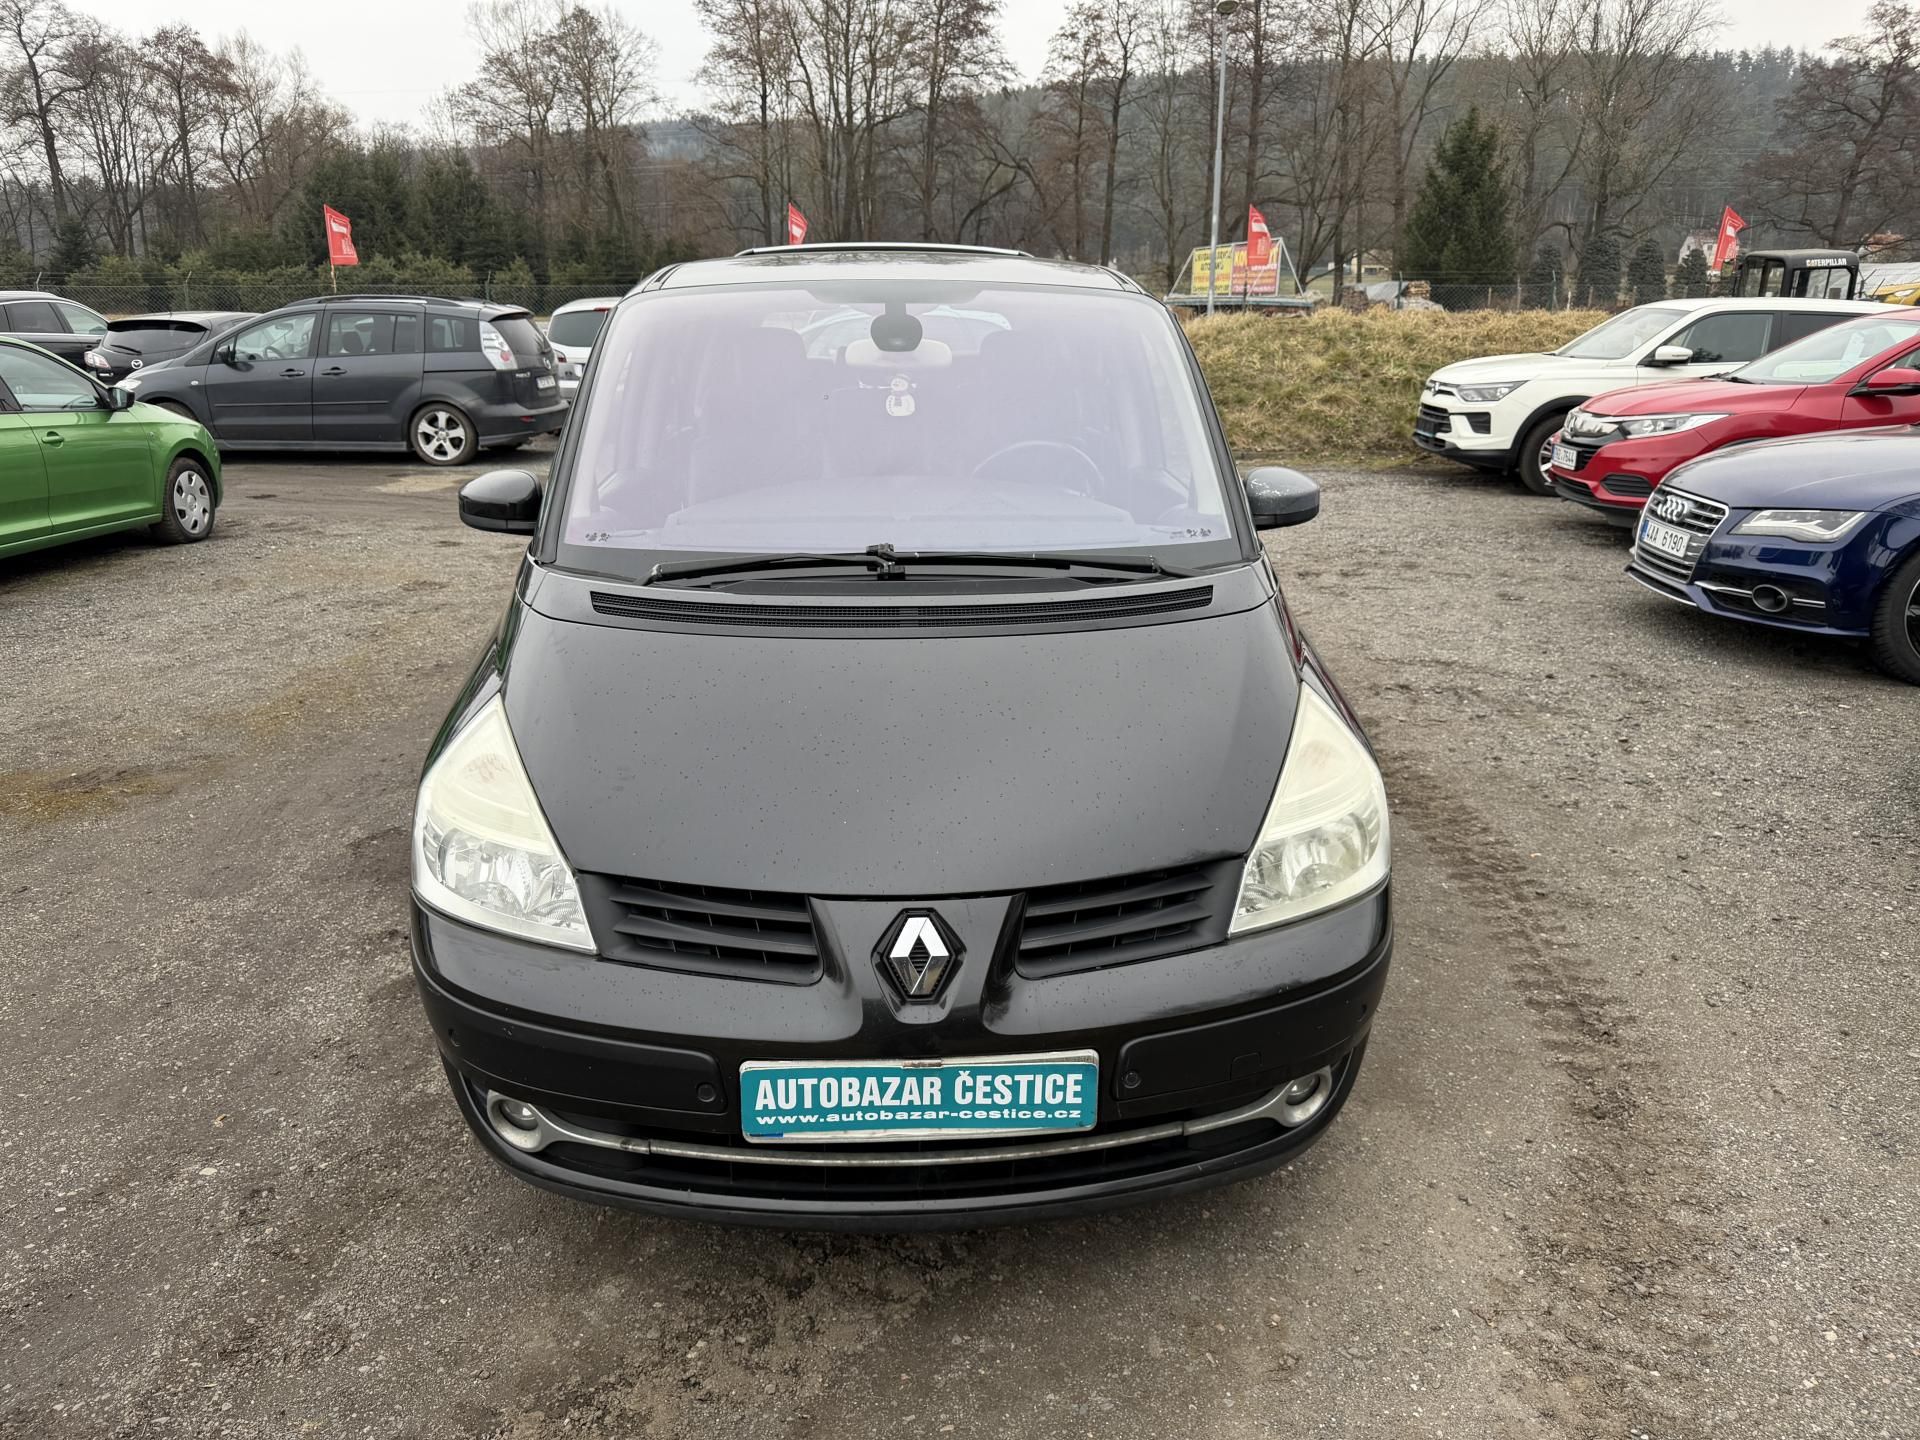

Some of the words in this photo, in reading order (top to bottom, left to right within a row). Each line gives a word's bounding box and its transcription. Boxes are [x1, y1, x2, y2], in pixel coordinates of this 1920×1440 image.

[1806, 258, 1847, 267] CATERPILLAR
[1646, 524, 1659, 543] 4AA
[1661, 531, 1684, 553] 6190
[755, 1076, 942, 1111] AUTOBAZAR
[954, 1070, 1083, 1106] ČESTICE
[756, 1108, 1082, 1125] www.autobazar-cestice.cz
